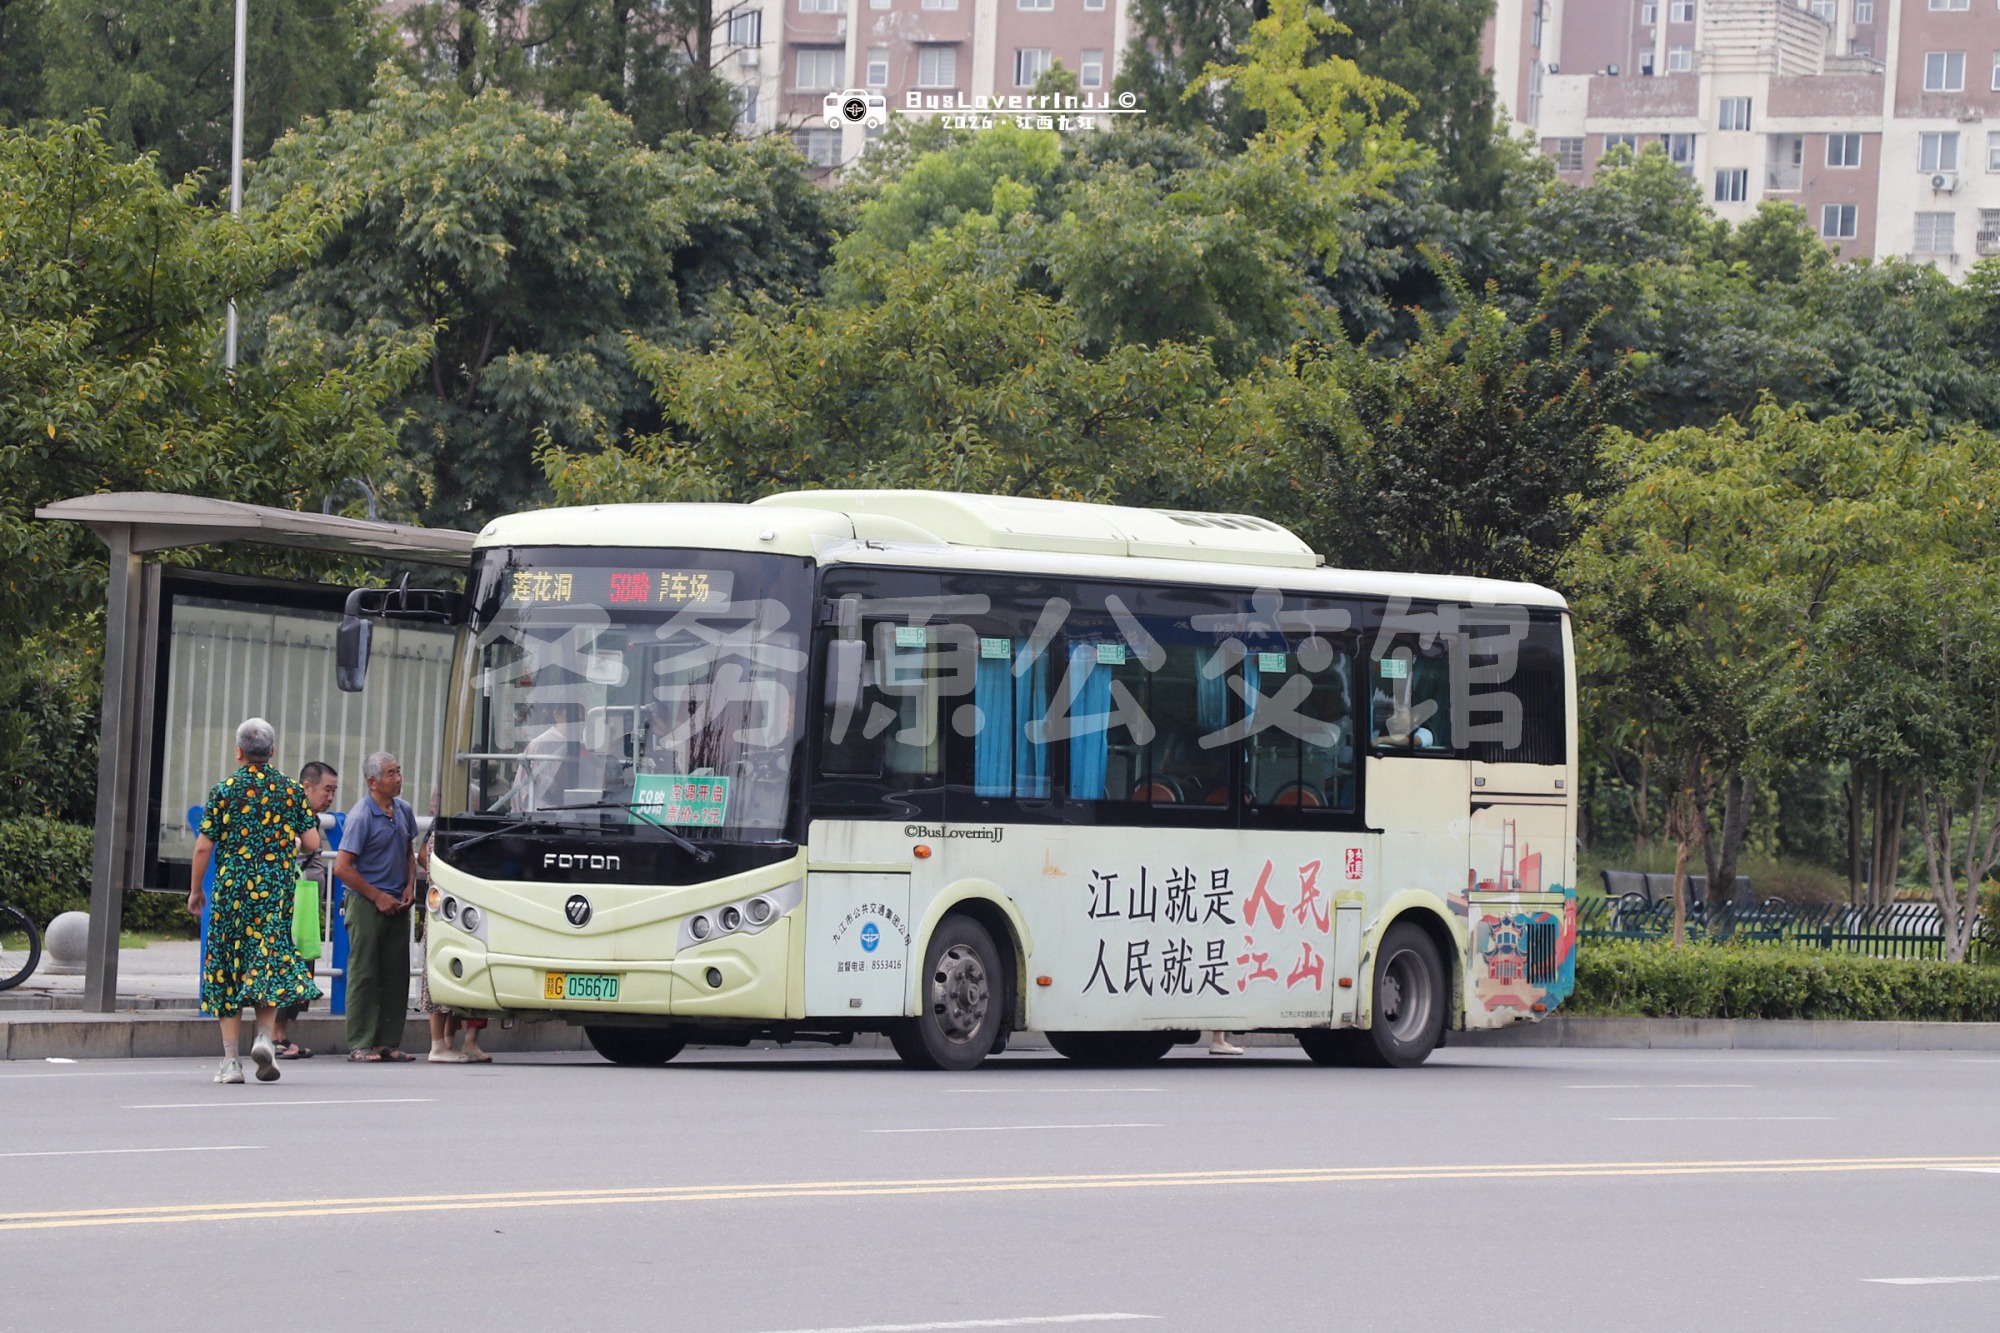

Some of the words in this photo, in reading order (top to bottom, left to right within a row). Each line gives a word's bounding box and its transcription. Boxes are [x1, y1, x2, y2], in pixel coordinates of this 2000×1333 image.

[512, 571, 573, 602] 莲花洞
[609, 572, 651, 603] 58路
[637, 789, 665, 815] 58路
[671, 784, 723, 803] 空调开启
[543, 853, 621, 871] FOTON
[1087, 859, 1331, 934] 江山就是人民
[832, 902, 912, 947] 九江市公共交通集团公司
[1081, 935, 1325, 996] 人民就是江山
